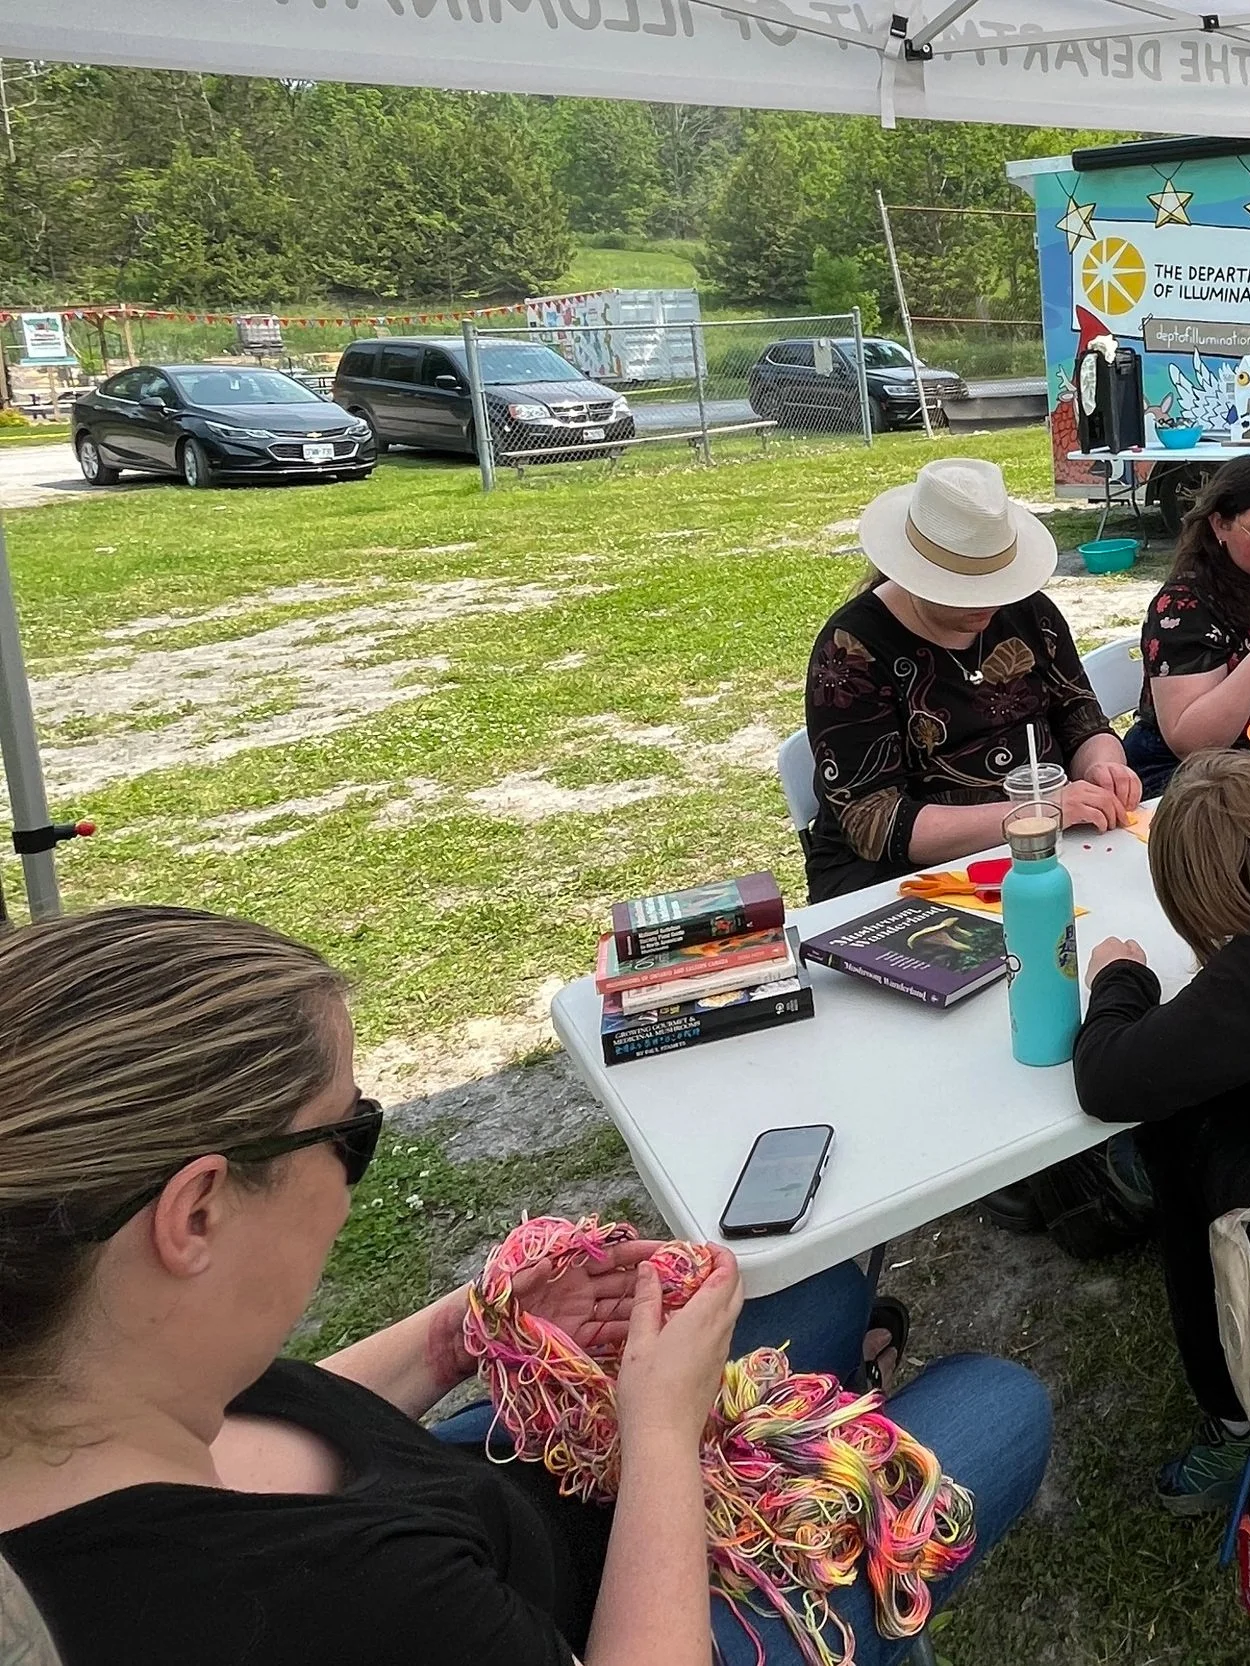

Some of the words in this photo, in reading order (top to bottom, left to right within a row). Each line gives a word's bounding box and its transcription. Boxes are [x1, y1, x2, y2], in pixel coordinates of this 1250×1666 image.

[1154, 264, 1182, 280] THE
[1153, 283, 1174, 298] OF
[829, 908, 922, 946] Mushroom
[849, 905, 948, 948] Wanderland
[843, 961, 883, 985] Mushroom
[883, 976, 928, 1002] Wanderland
[613, 1033, 653, 1046] MEDICINAL
[654, 1020, 701, 1037] MUSHROOMS
[614, 1026, 652, 1039] GROWING
[652, 1017, 688, 1031] GOURMET
